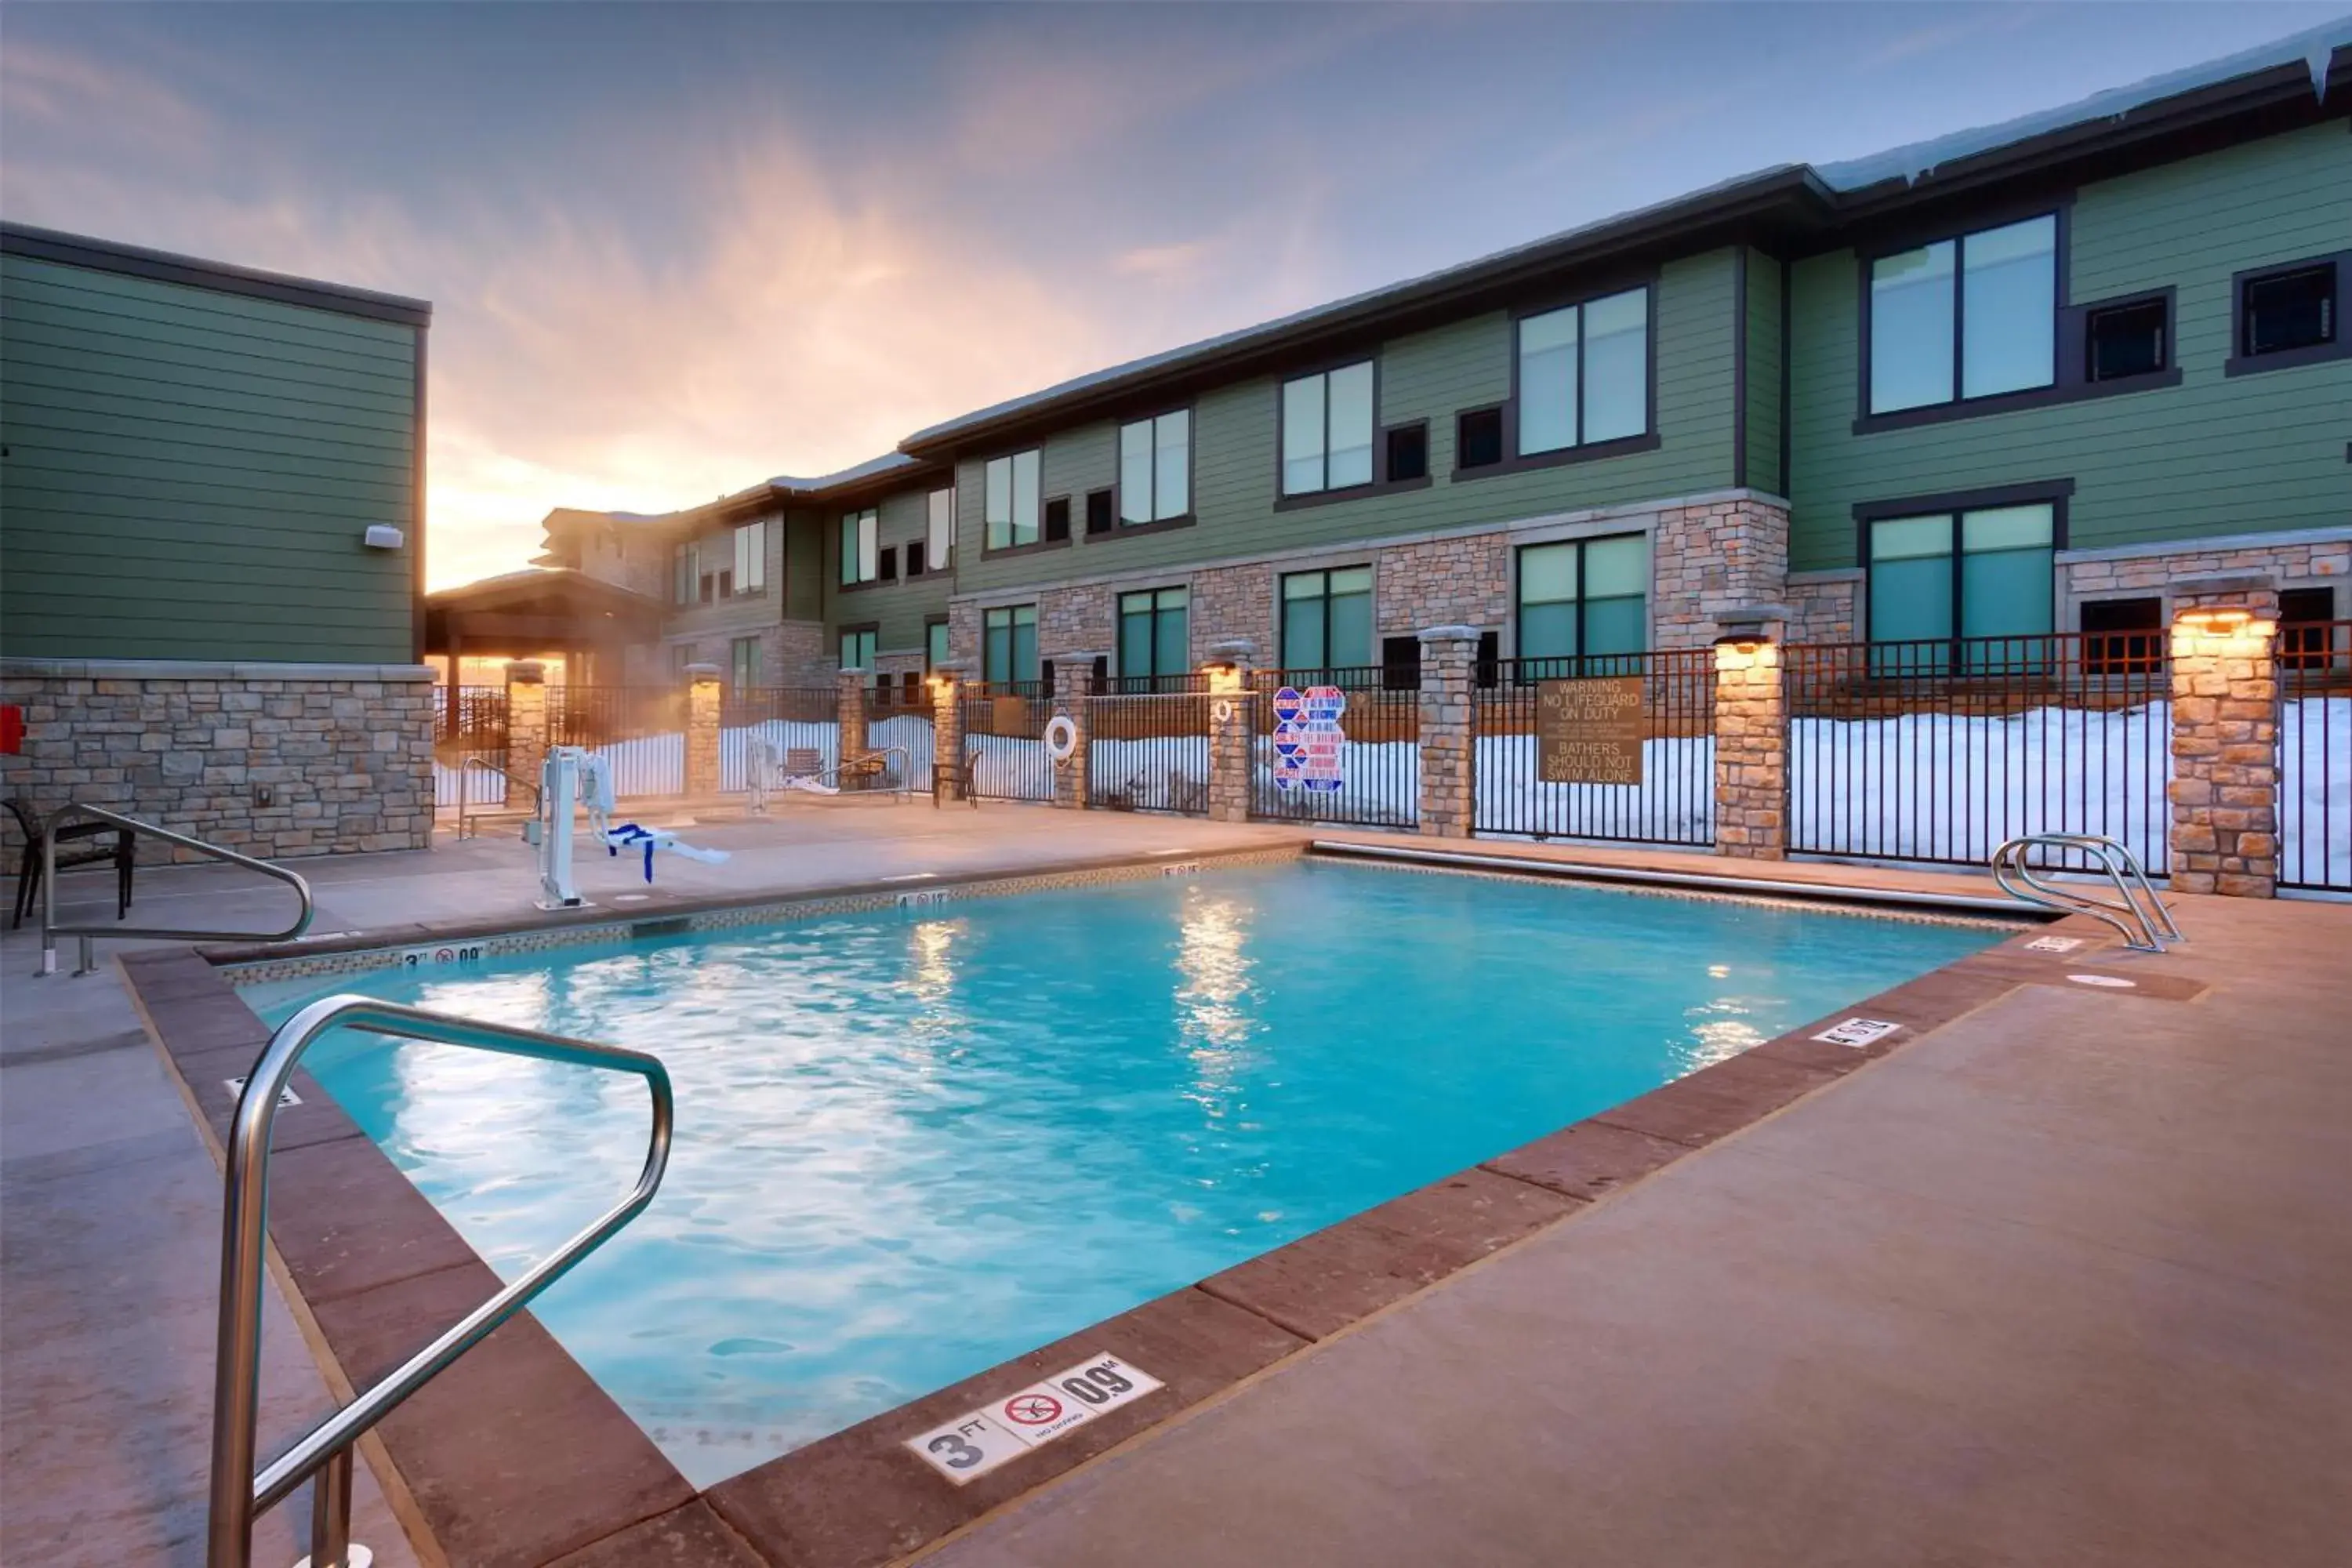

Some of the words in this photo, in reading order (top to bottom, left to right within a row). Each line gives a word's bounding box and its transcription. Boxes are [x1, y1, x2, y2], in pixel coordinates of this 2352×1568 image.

[1559, 681, 1621, 693] WARNING
[1544, 695, 1562, 707] NO
[1566, 693, 1639, 707] LIFEGUARD
[1560, 707, 1578, 720] ON
[1584, 707, 1620, 720] DUTY
[1559, 742, 1621, 755] BATHERS
[1547, 755, 1600, 768] SHOULD
[1607, 756, 1633, 769] NOT
[1547, 768, 1583, 780] SWIM
[1588, 769, 1633, 782] ALONE
[927, 1435, 984, 1468] 3
[958, 1419, 985, 1438] FT
